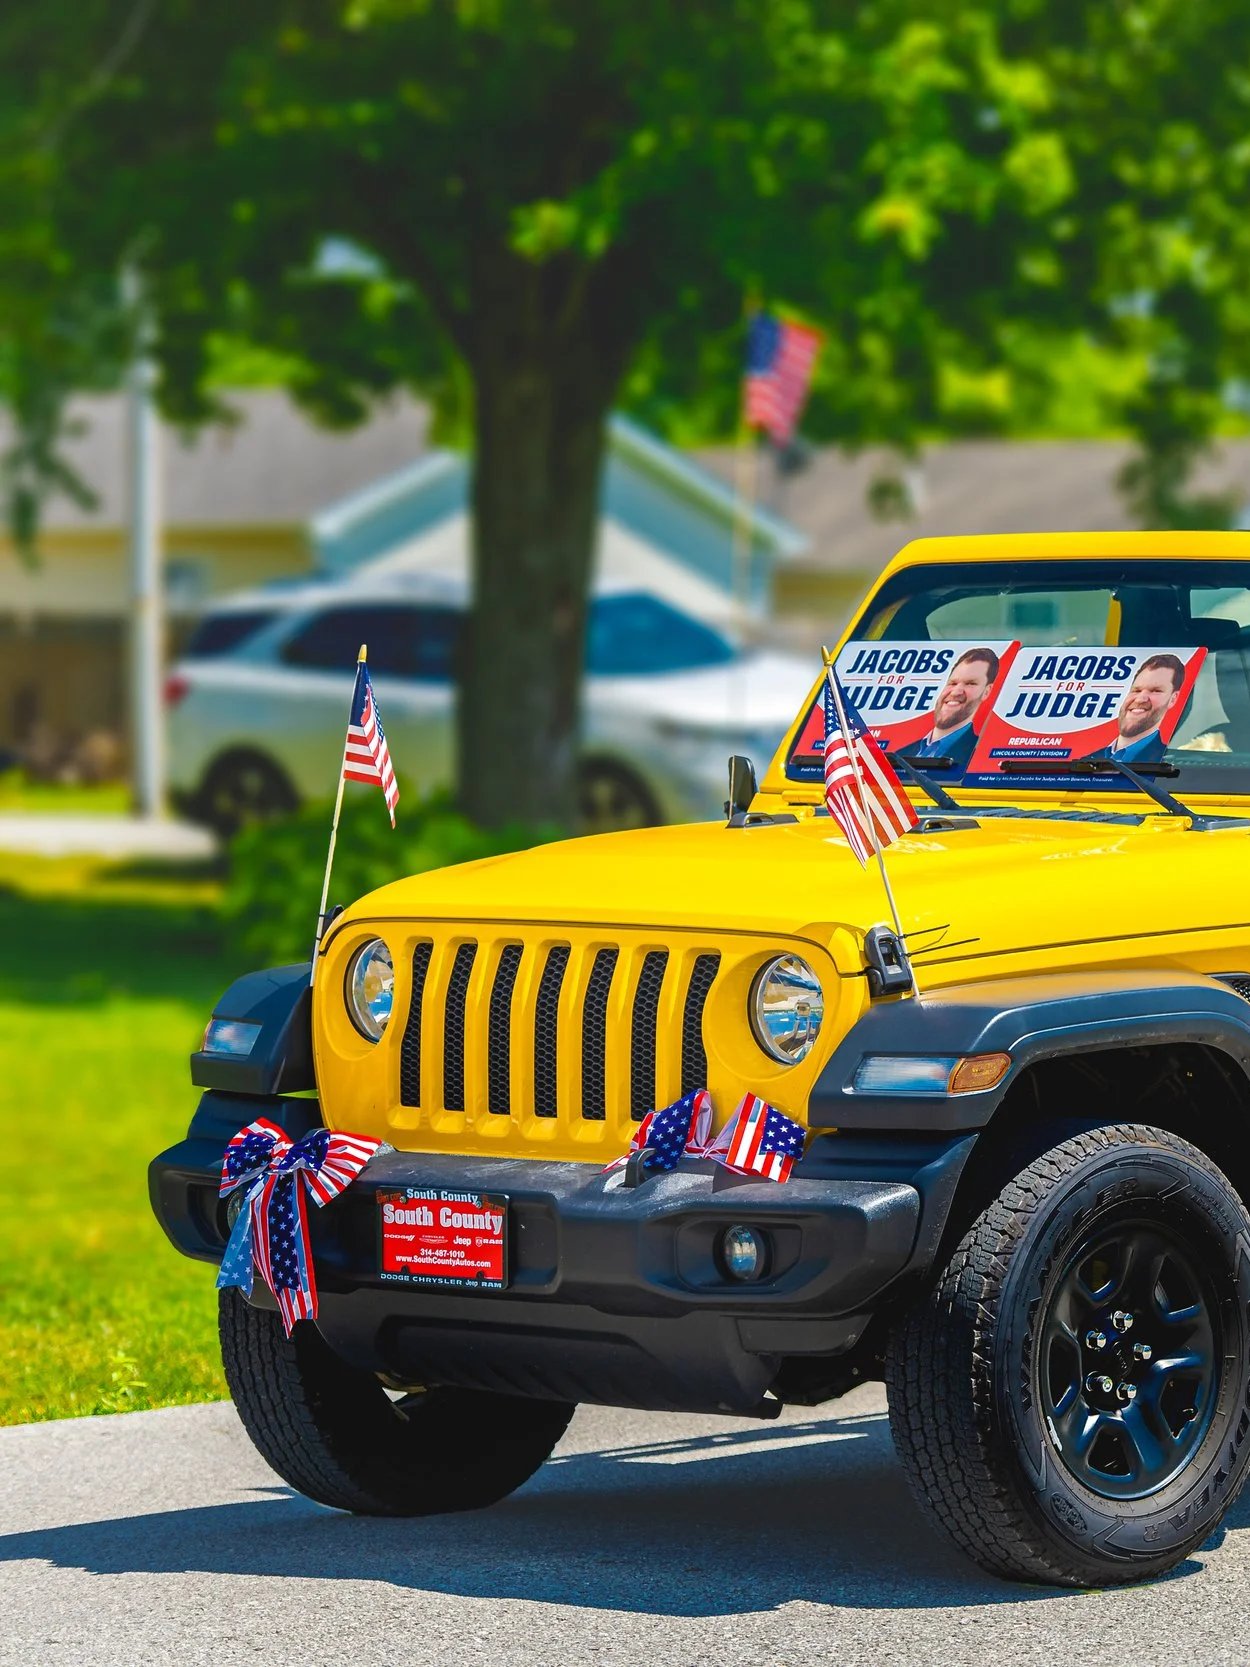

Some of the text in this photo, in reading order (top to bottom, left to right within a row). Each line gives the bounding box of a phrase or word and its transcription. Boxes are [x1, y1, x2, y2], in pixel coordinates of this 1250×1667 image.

[846, 649, 954, 674] JACOBS
[1022, 655, 1137, 681] JACOBS
[878, 675, 905, 685] FOR
[1056, 681, 1086, 692] FOR
[1005, 693, 1122, 719] JUDGE
[1008, 737, 1063, 746] REPUBLICAN
[406, 1188, 437, 1200] South
[440, 1190, 479, 1203] County
[383, 1204, 503, 1235] South County
[453, 1235, 472, 1246] Jeep
[420, 1248, 465, 1258] 314-487-1010
[395, 1255, 491, 1268] www.SouthCountyAutos.com
[380, 1273, 410, 1281] DODGE
[412, 1276, 462, 1286] CHRYSLER
[465, 1279, 479, 1287] Jeep
